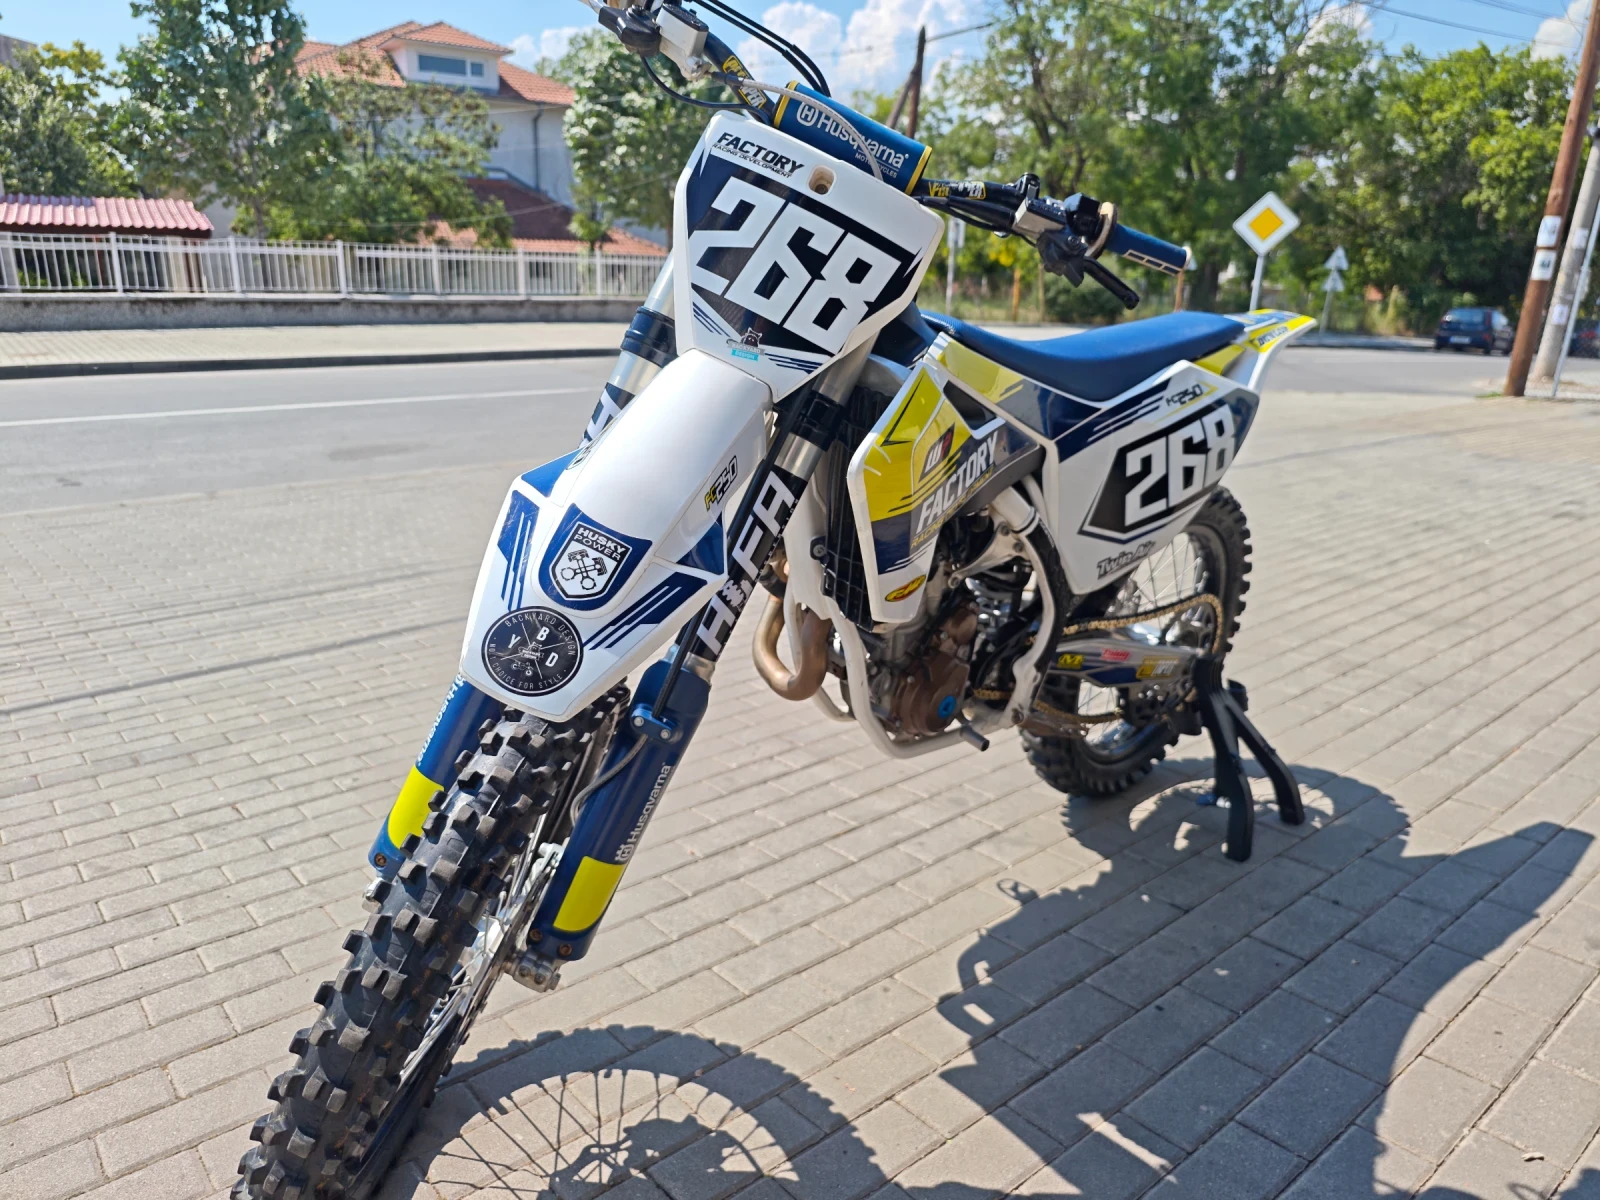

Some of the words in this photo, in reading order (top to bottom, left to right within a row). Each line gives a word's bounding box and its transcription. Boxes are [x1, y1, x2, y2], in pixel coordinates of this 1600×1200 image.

[712, 142, 738, 156] RACING
[739, 152, 793, 178] DEVELOPMENT
[717, 132, 804, 174] FACTORY
[855, 152, 898, 179] MOTYCLES
[689, 175, 902, 356] 268
[704, 455, 738, 511] FC250
[916, 431, 998, 535] FACTORY
[1124, 403, 1235, 527] 268
[573, 534, 622, 561] POWER
[577, 527, 626, 554] HUSKY
[504, 612, 557, 628] BACKYARD
[558, 624, 576, 656] DESIGN
[508, 634, 521, 649] Y
[536, 626, 550, 641] B
[492, 662, 516, 685] CHOICE
[518, 681, 534, 690] FOR
[538, 673, 563, 689] STYLE
[545, 652, 559, 667] D
[627, 765, 671, 843] Husqvarna
